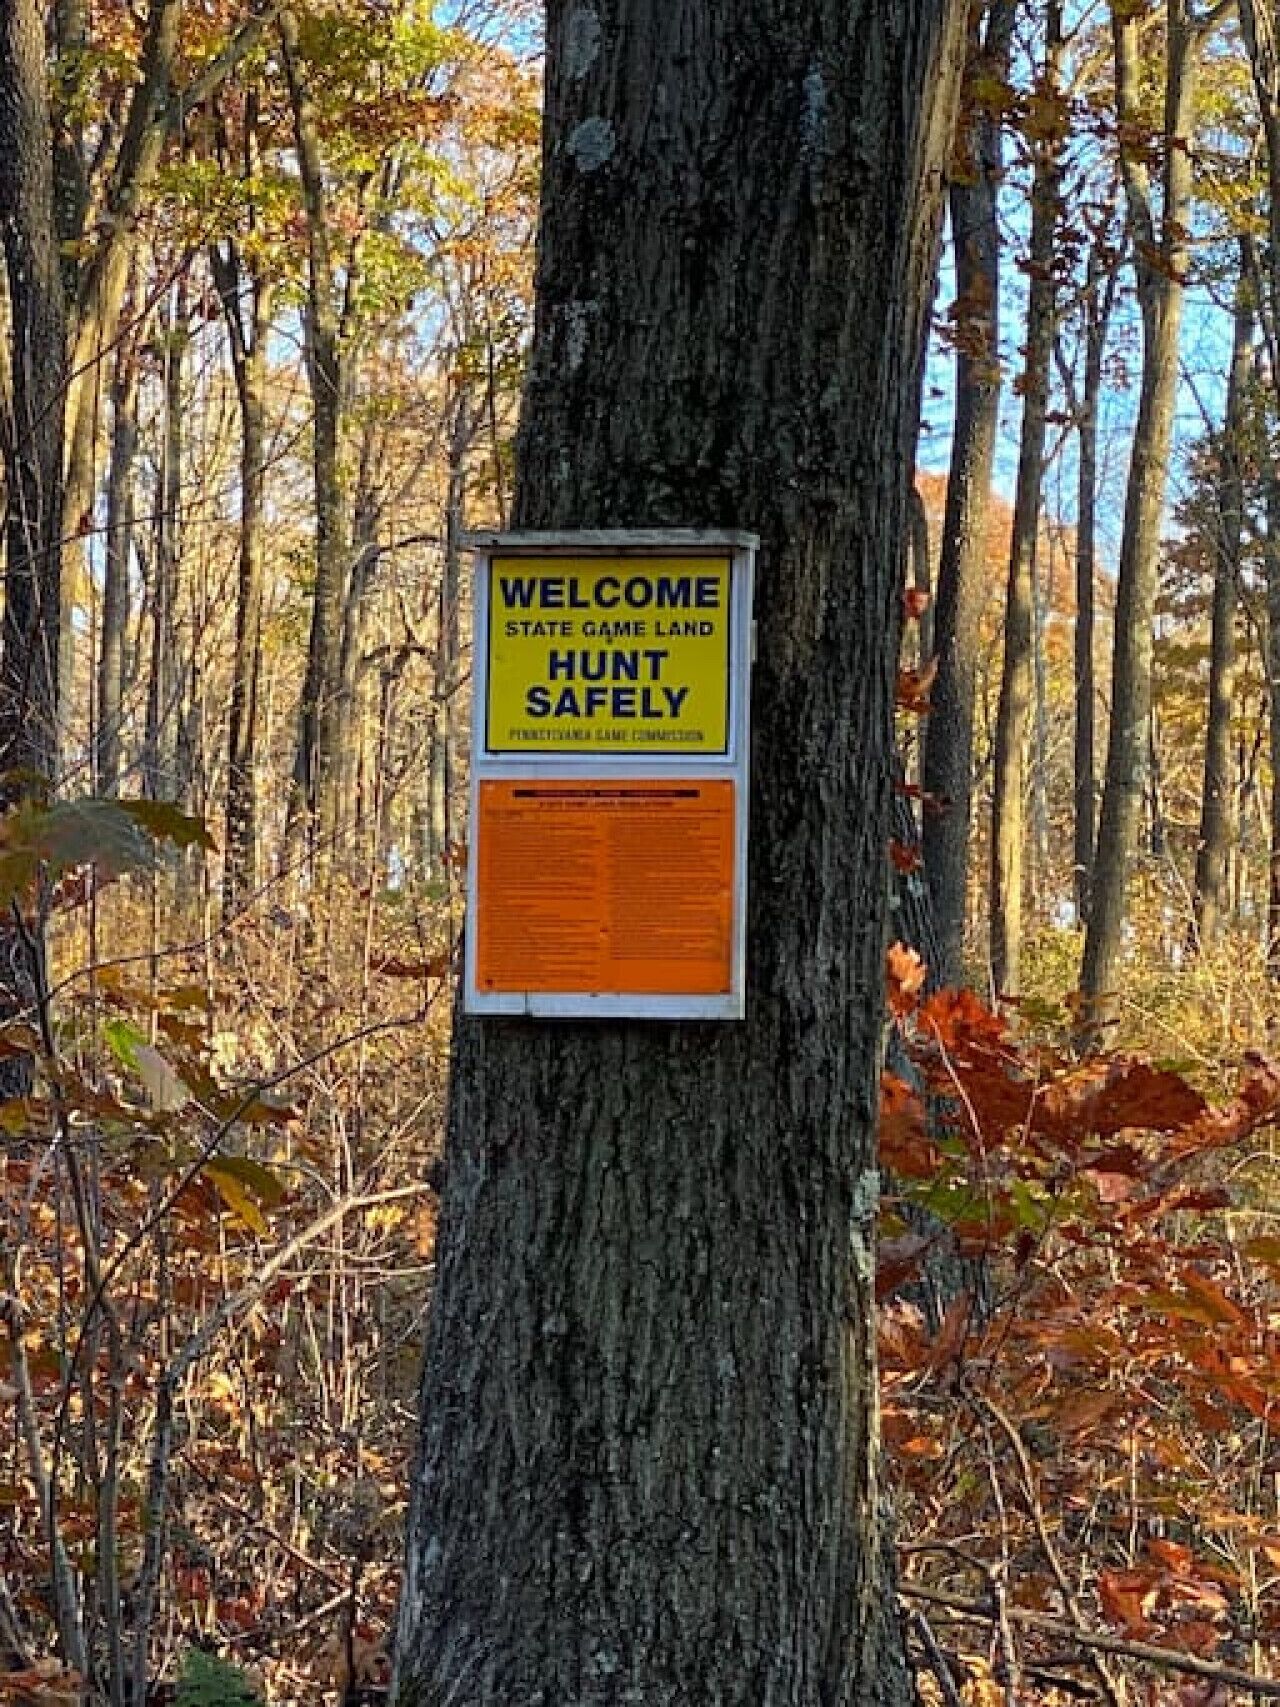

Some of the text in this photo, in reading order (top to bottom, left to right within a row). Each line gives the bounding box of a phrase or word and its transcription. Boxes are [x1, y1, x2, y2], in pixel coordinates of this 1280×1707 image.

[499, 576, 721, 609] WELCOME
[504, 620, 714, 637] STATE GAME LAND
[549, 649, 669, 681] HUNT
[526, 686, 689, 718] SAFELY
